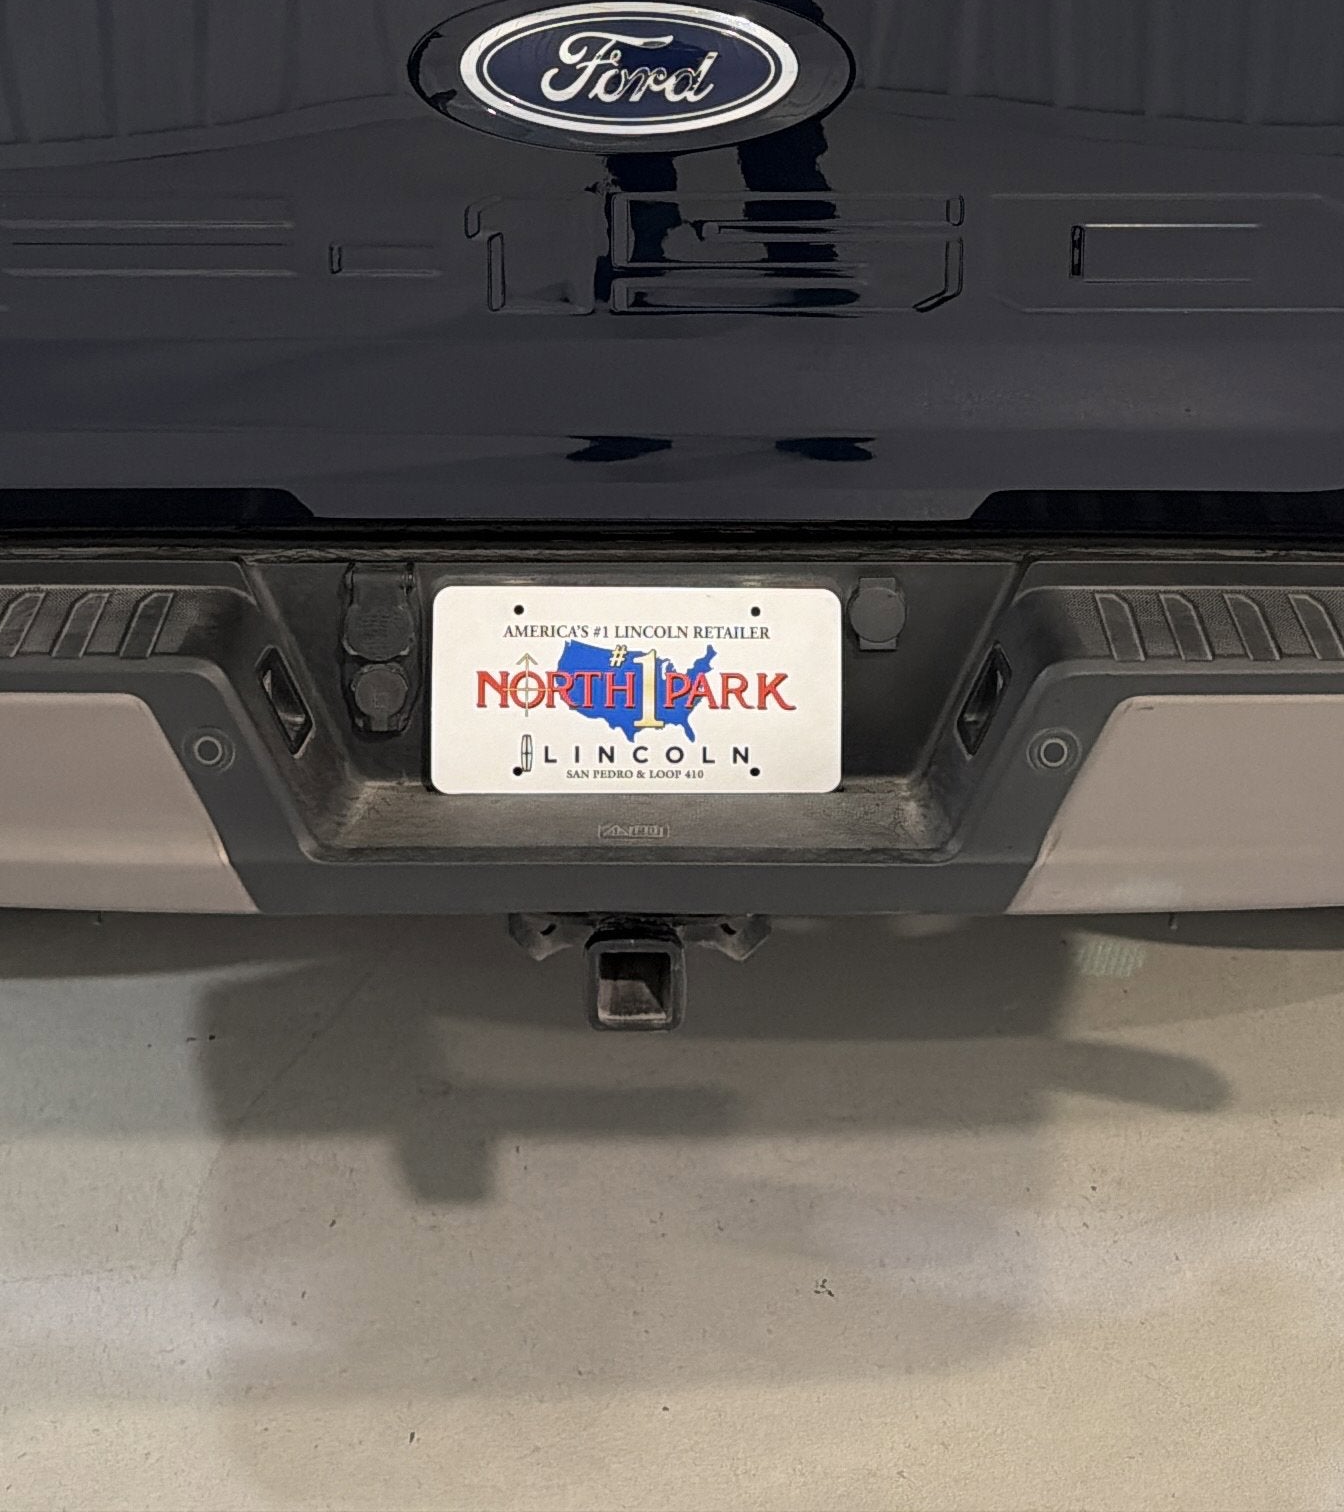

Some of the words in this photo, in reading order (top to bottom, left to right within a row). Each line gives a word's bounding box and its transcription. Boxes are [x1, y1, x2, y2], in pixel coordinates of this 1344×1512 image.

[540, 30, 719, 102] Ford
[503, 624, 590, 639] AMERICA'S
[593, 625, 609, 639] #1
[614, 625, 689, 639] LINCOLN
[693, 626, 771, 640] RETAILER
[476, 670, 636, 710] NORTH
[663, 671, 797, 711] PARK
[544, 745, 749, 764] LINCOLN
[566, 769, 590, 779] SAN
[593, 769, 634, 779] PEDRO
[636, 769, 646, 779] &
[649, 769, 682, 779] LOOP
[685, 769, 705, 779] 410
